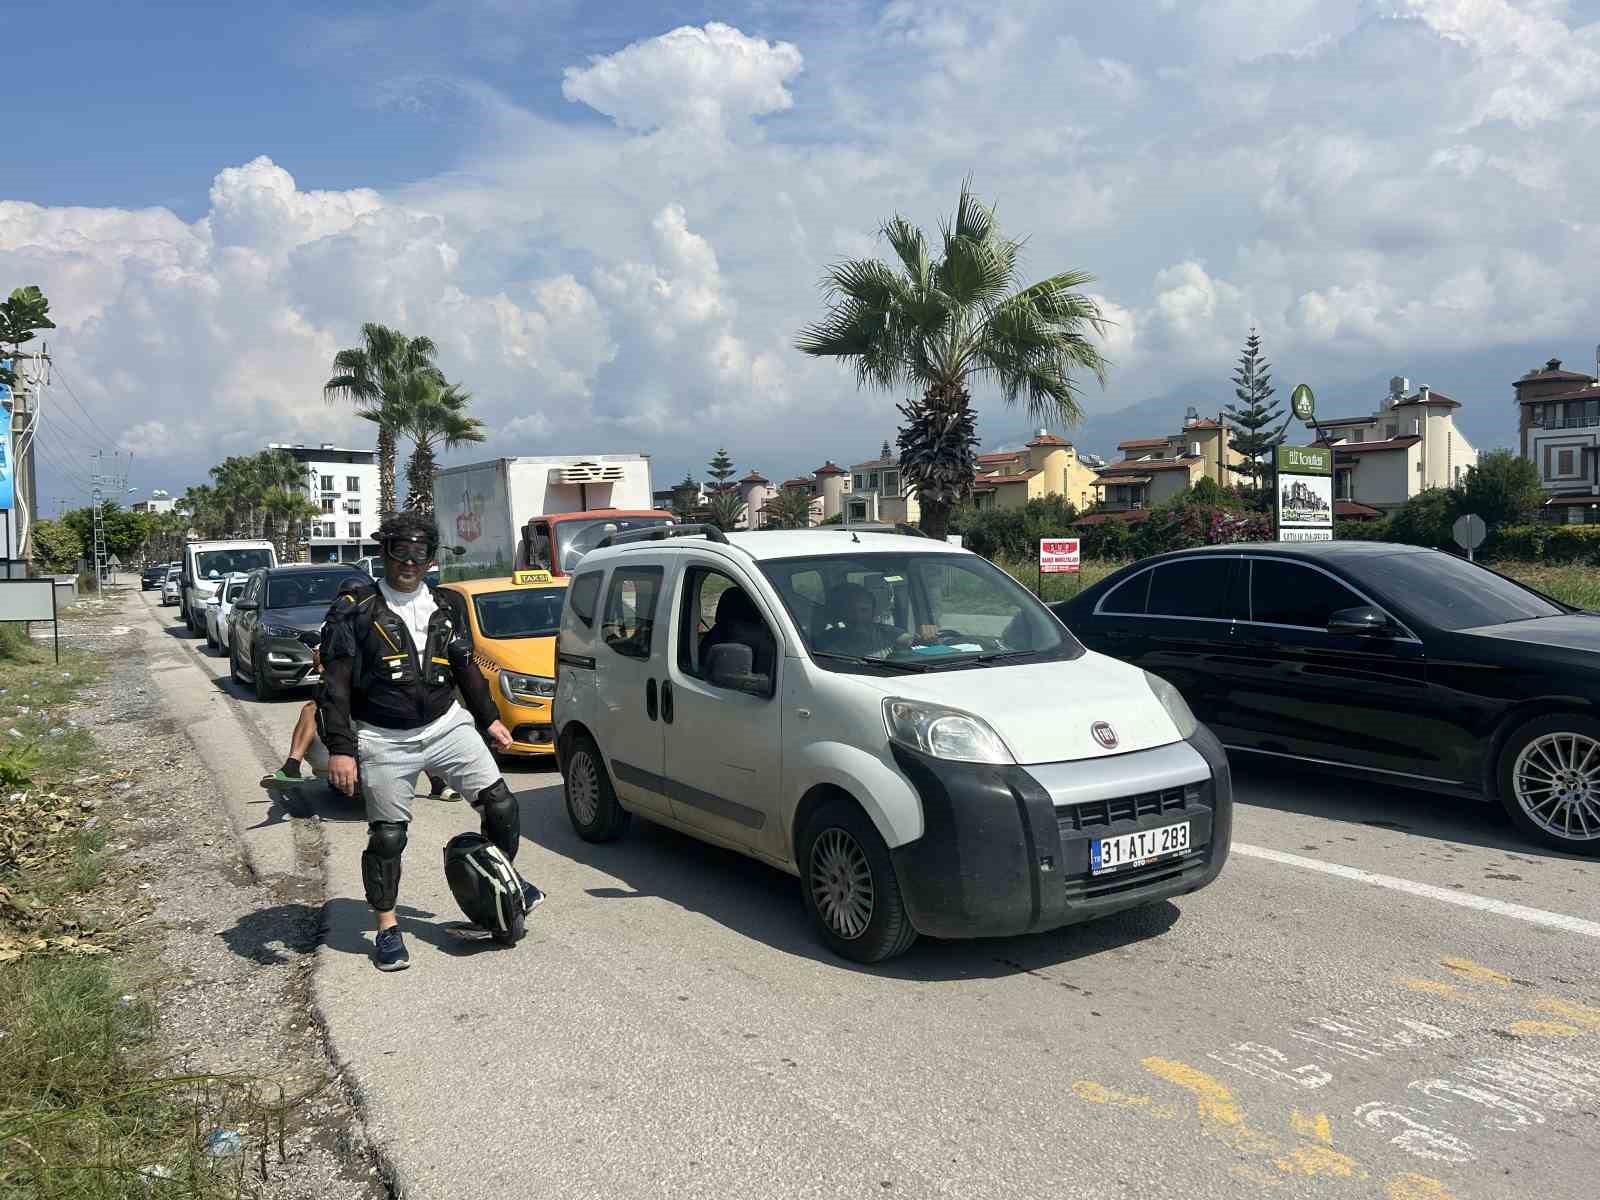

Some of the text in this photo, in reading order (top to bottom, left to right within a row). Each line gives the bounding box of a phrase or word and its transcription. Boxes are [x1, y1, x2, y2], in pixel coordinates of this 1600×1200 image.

[1102, 840, 1121, 864] 31
[1128, 832, 1156, 860] ATJ
[1161, 825, 1187, 852] 283
